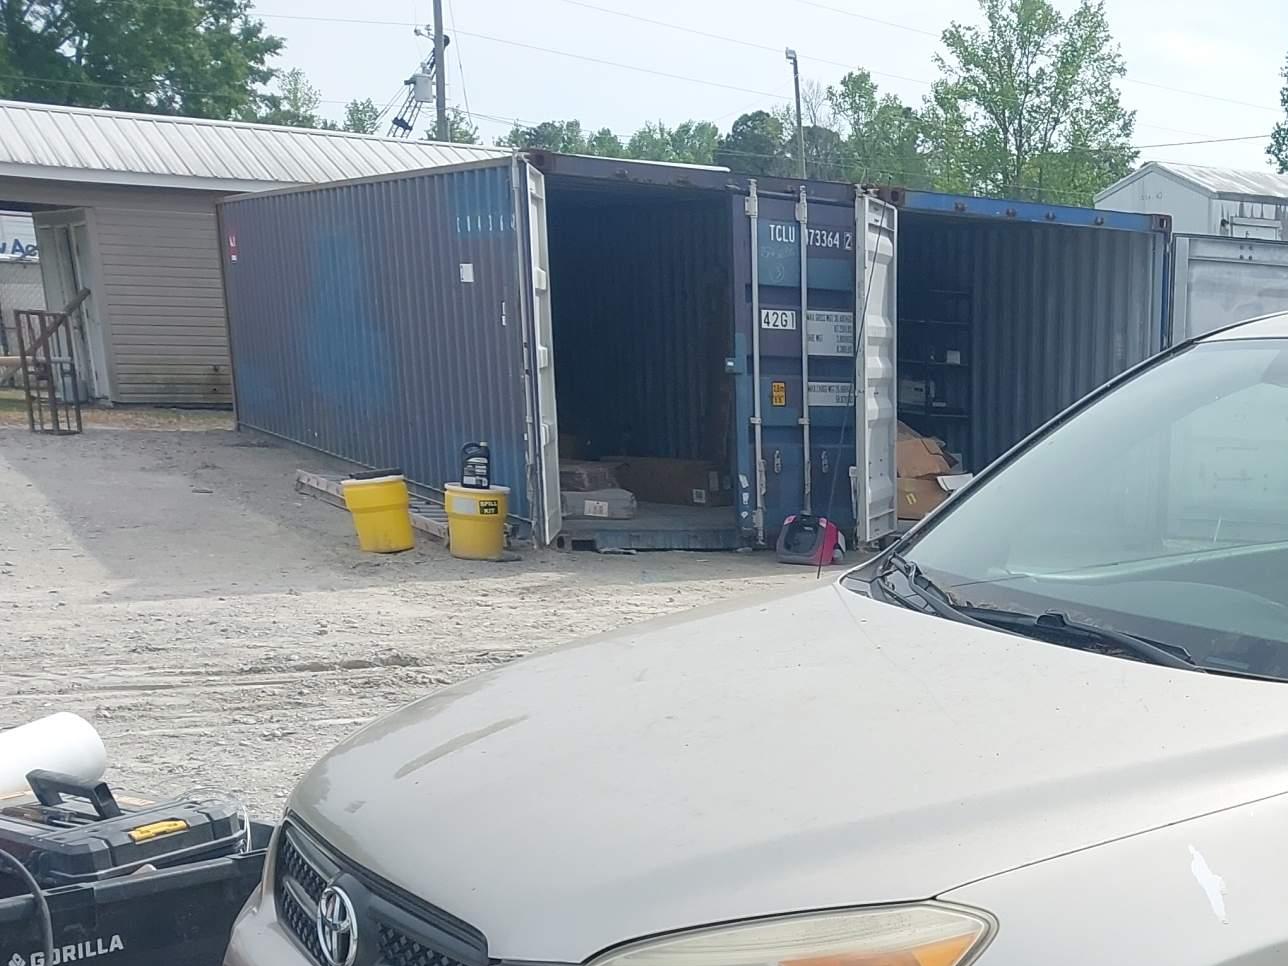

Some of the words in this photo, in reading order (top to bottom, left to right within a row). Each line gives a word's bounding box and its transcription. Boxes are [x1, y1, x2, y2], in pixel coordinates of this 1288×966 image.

[769, 224, 796, 243] TCLU
[805, 228, 840, 249] 73364
[845, 233, 852, 249] 2
[763, 311, 795, 328] 42G1
